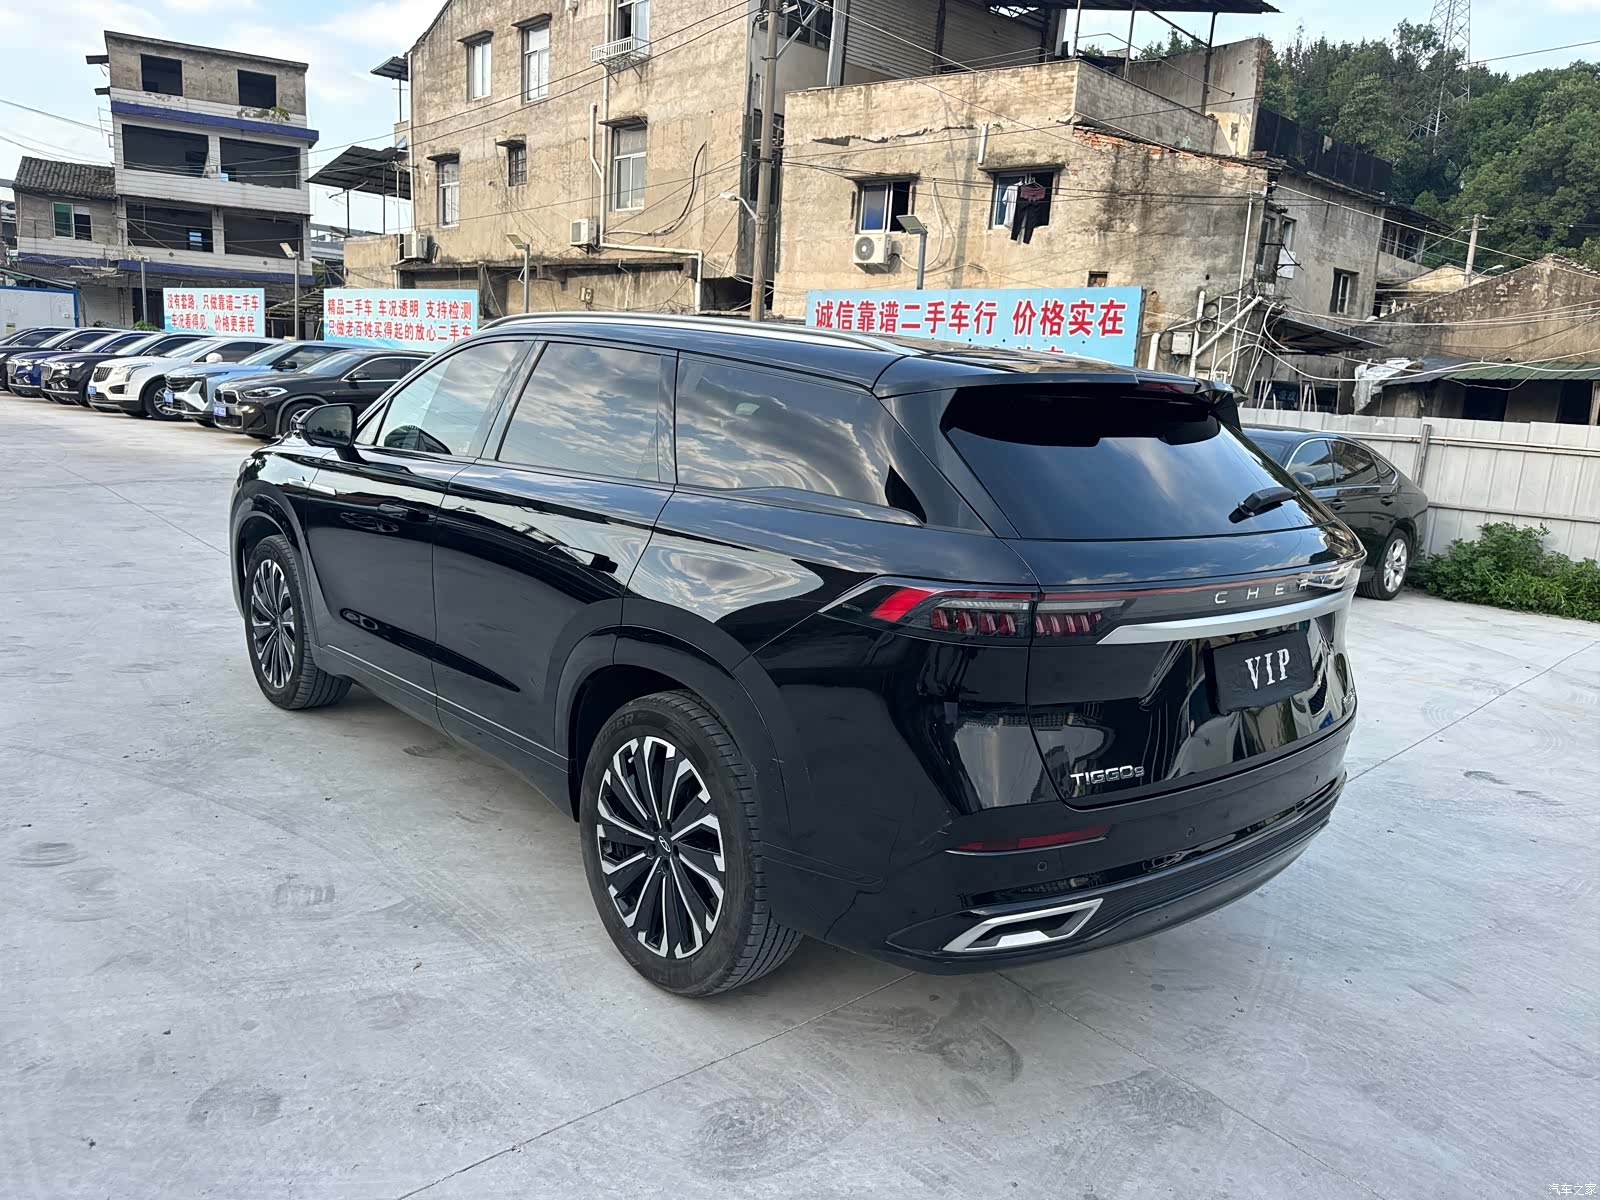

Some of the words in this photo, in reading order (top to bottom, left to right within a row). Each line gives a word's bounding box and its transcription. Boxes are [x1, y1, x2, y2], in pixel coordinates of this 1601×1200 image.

[327, 298, 373, 316] 精品二手车
[378, 299, 419, 318] 车况透明
[425, 300, 472, 320] 支持检测
[815, 300, 998, 335] 诚信靠谱二手车行
[1012, 299, 1127, 337] 价格实在
[328, 319, 472, 342] 只做老百姓买得起的放心二手车
[1244, 648, 1290, 690] VIP
